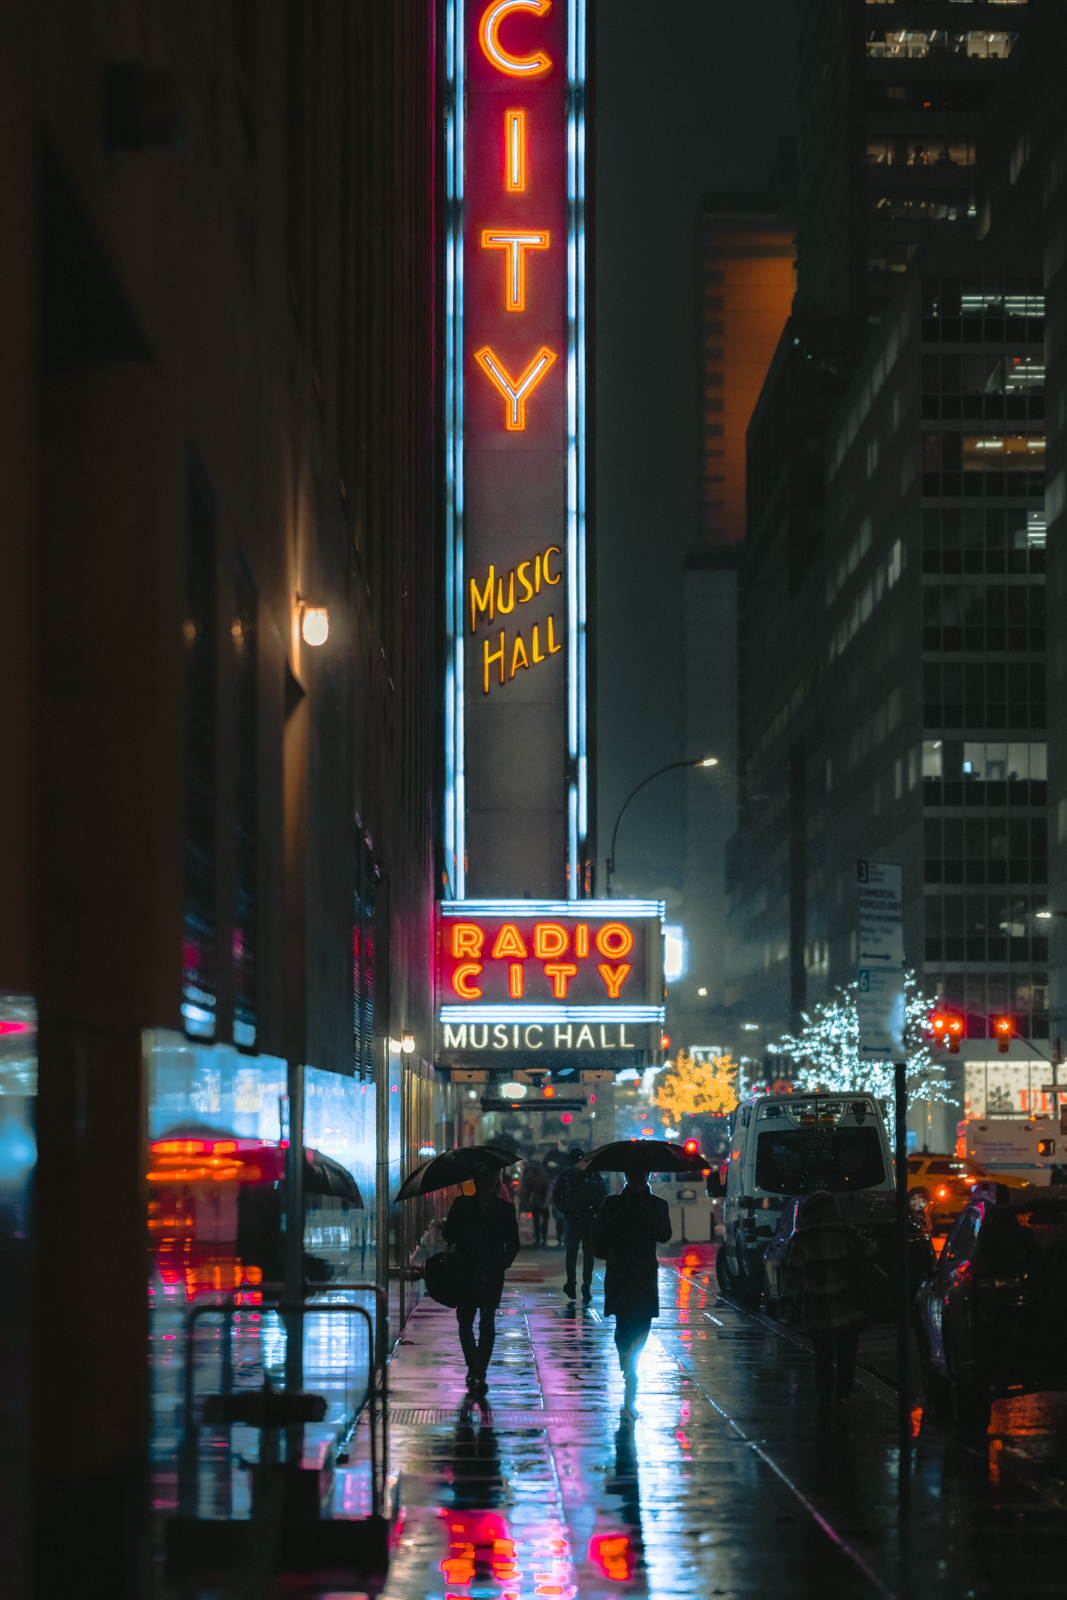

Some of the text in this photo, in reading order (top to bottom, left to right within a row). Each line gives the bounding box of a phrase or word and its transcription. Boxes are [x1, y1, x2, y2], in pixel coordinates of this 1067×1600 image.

[473, 0, 557, 431] CITY
[470, 546, 561, 632] MUSIC
[484, 616, 562, 692] HALL
[859, 862, 867, 881] 3
[452, 922, 634, 959] RADIO
[452, 963, 631, 999] CITY
[860, 972, 868, 990] 6
[443, 1024, 635, 1049] MUSIC HALL
